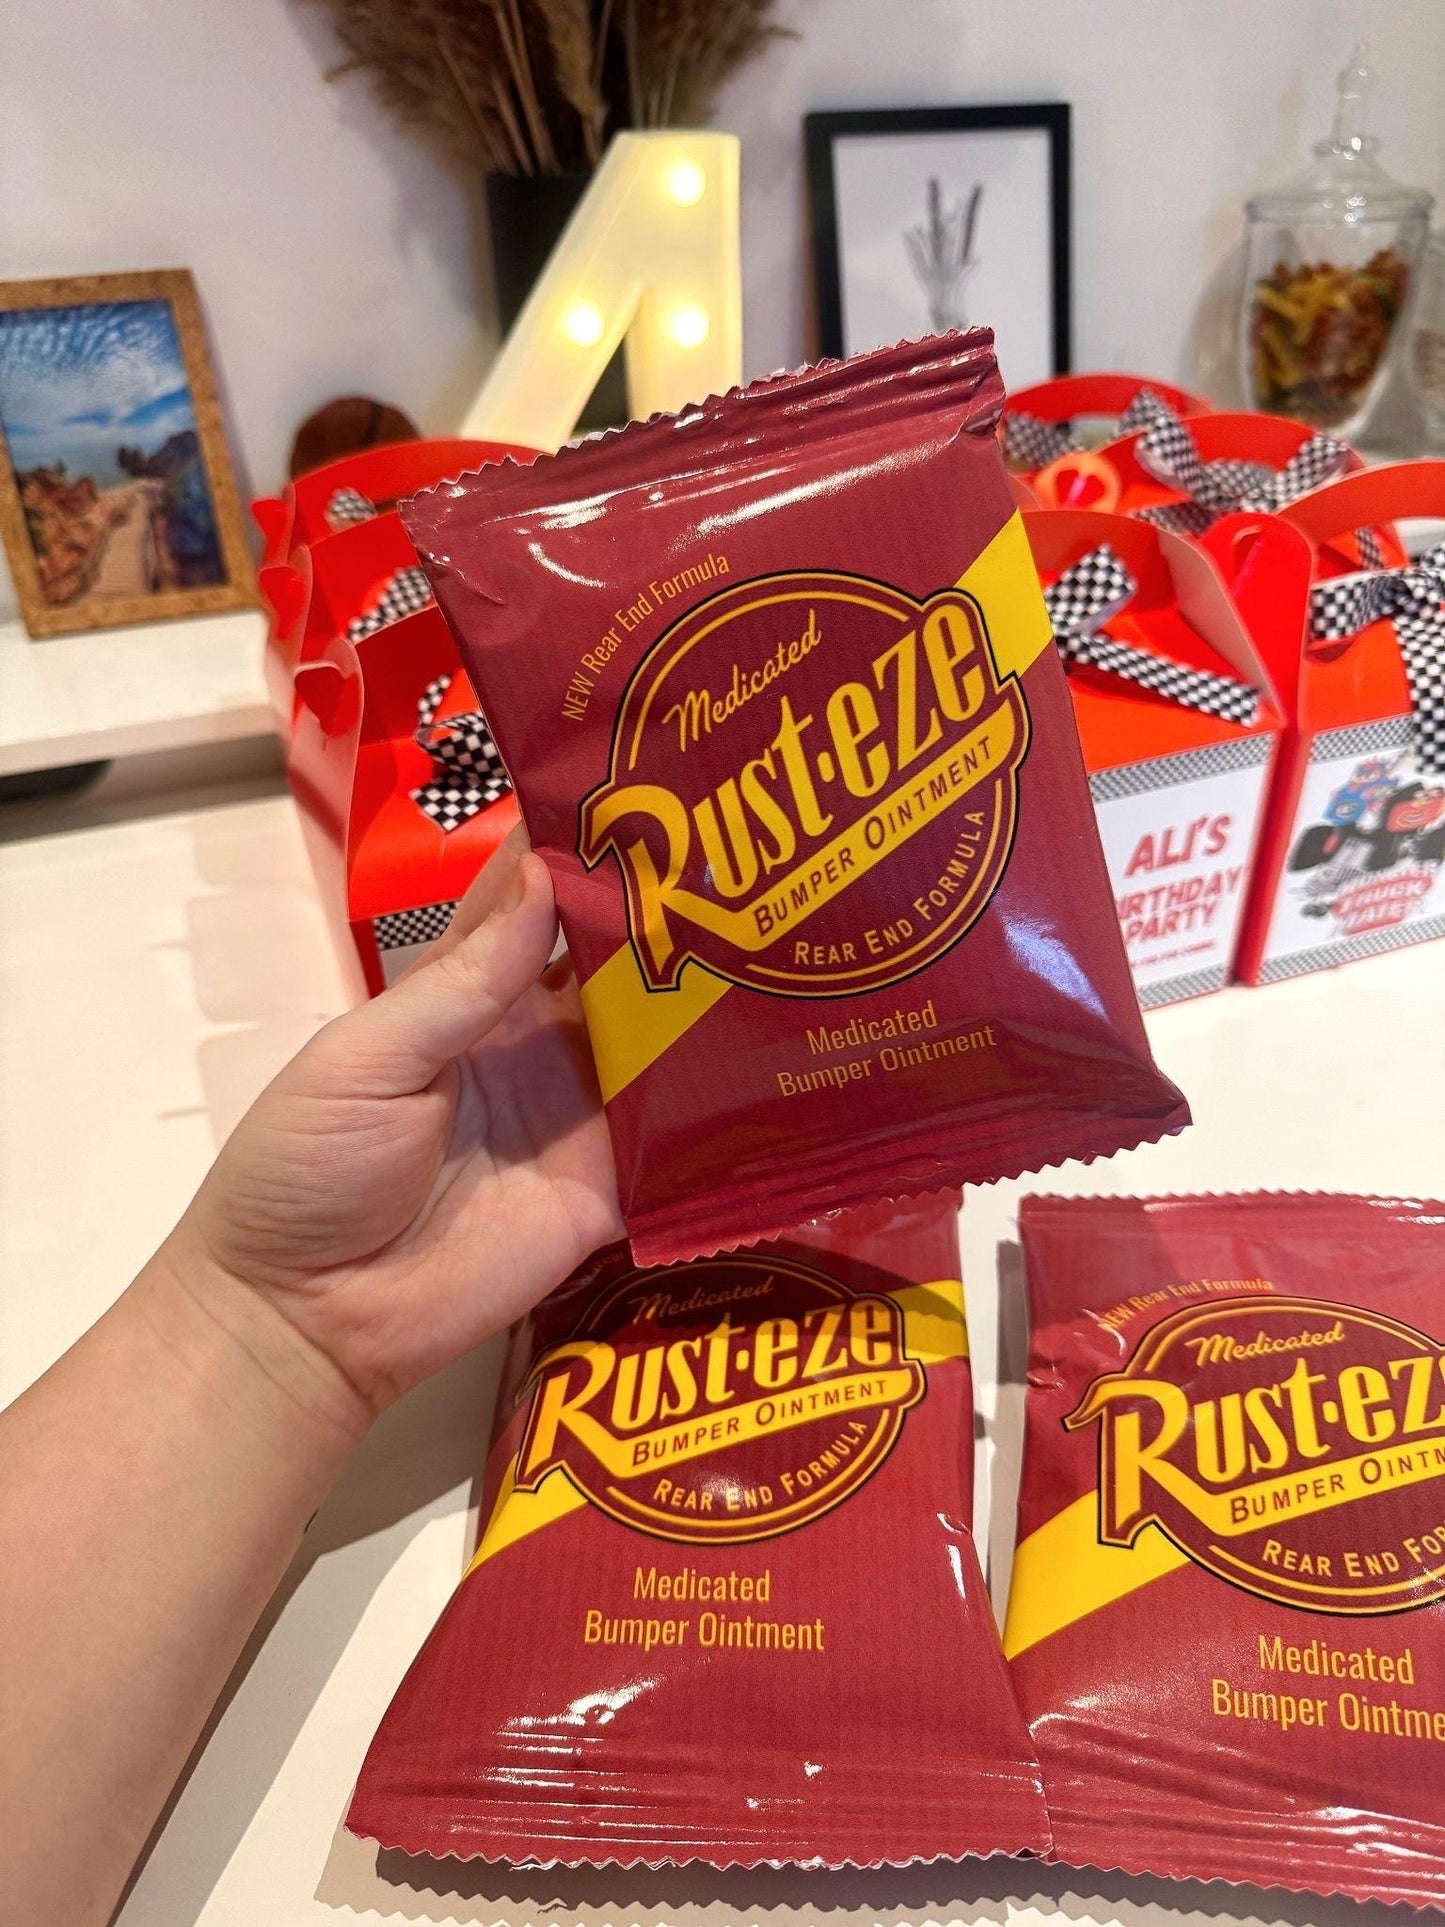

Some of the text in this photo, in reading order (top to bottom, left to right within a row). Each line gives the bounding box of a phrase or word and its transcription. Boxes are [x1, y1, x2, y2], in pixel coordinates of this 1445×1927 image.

[562, 553, 730, 721] NEW Rear End Formula
[661, 608, 822, 752] Medicated
[753, 735, 995, 937] BUMPER OINTMENT
[1124, 813, 1231, 878] ALI'S
[794, 809, 986, 966] REAR END FORMULA
[1116, 866, 1242, 920] IRTHDAY
[1125, 899, 1217, 944] PARTY
[806, 1000, 938, 1055] Medicated
[776, 1024, 998, 1098] Bumper Ointment
[627, 1275, 774, 1325] Medicated
[1129, 1288, 1169, 1312] Rear
[1168, 1282, 1201, 1298] End
[1200, 1277, 1275, 1293] Formula
[1184, 1321, 1346, 1367] Medicated
[632, 1379, 889, 1467] BUMPER OINTMENT
[653, 1420, 868, 1512] REAR END FORMULA
[1230, 1473, 1345, 1525] BUMPER
[633, 1566, 772, 1603] Medicated
[1262, 1538, 1333, 1577] REAR
[1343, 1551, 1401, 1578] END
[584, 1609, 826, 1651] Bumper Ointment
[1258, 1634, 1415, 1685] Medicated
[1211, 1678, 1329, 1731] Bumper
